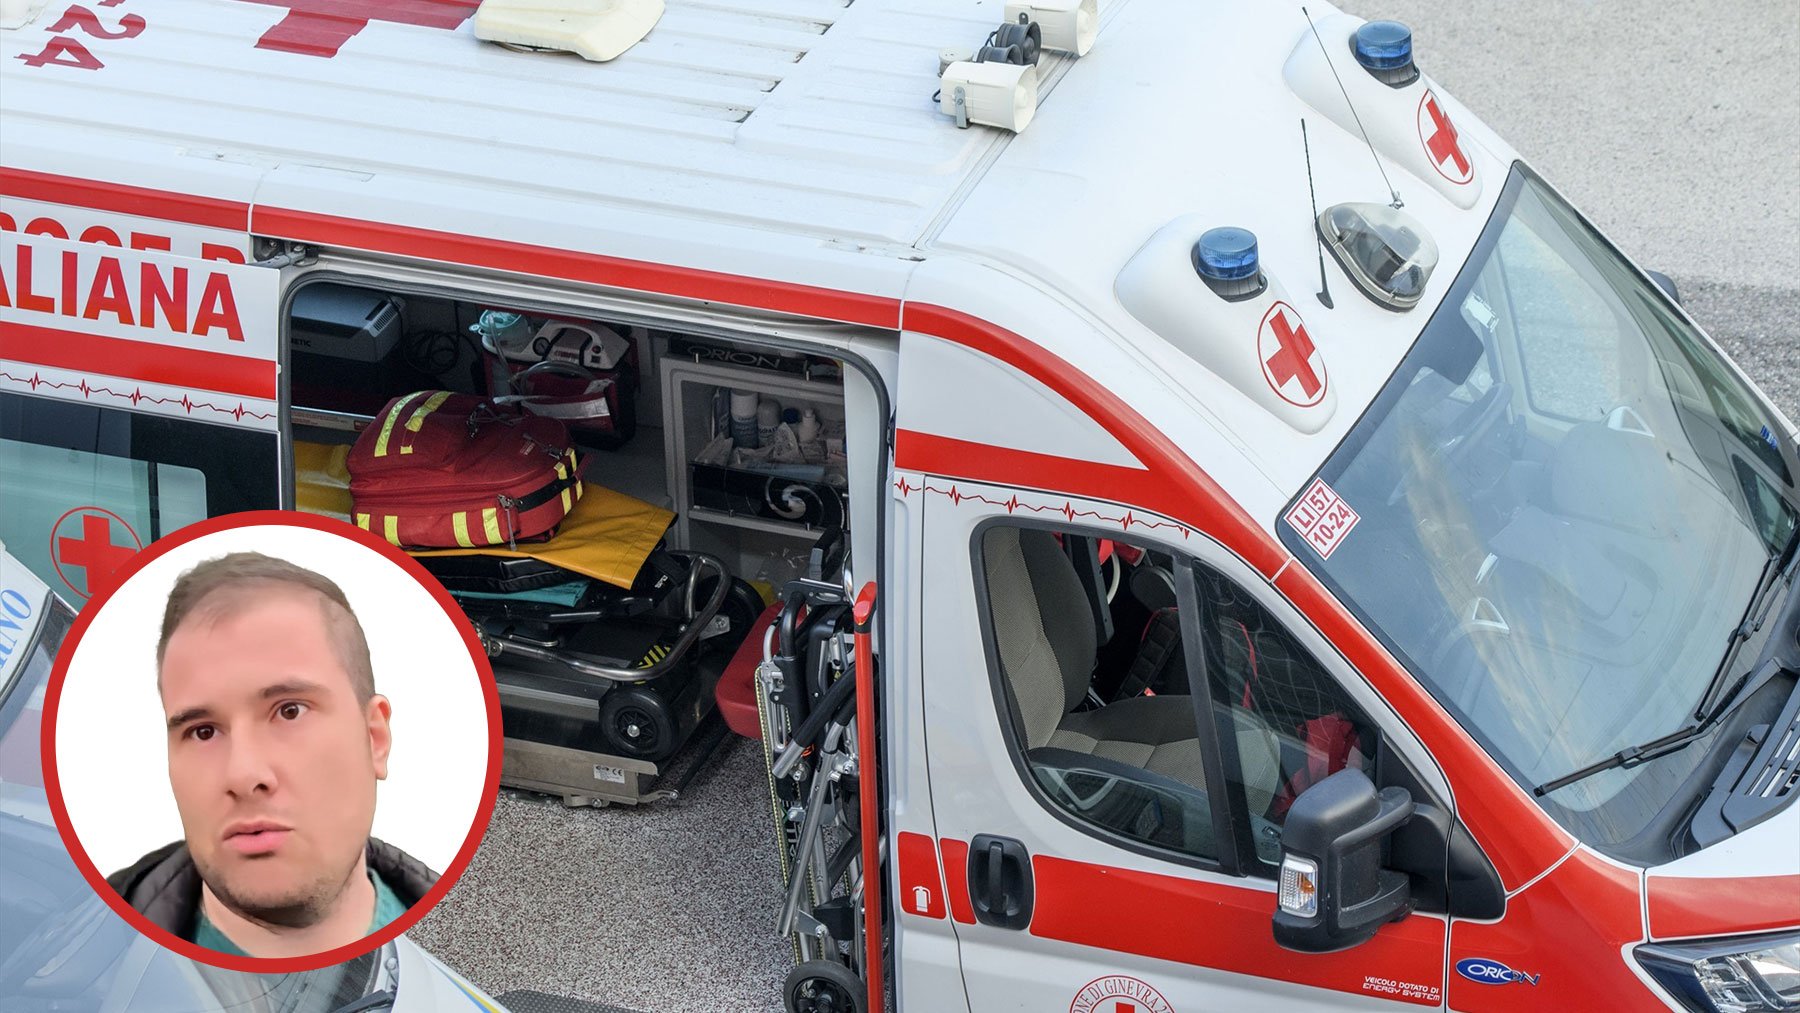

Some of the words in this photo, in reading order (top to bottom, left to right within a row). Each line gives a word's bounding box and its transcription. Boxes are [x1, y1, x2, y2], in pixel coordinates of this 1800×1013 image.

[0, 243, 245, 342] LIANA
[687, 345, 781, 369] ORION
[1294, 506, 1315, 529] LI
[1309, 486, 1330, 511] 57
[1313, 504, 1351, 546] 10-24
[1087, 983, 1104, 1000] DI
[1104, 979, 1159, 1009] GINEVRA
[1362, 982, 1401, 994] ENERGY
[1402, 989, 1440, 1001] SYSTEM
[1364, 976, 1397, 987] VEICOLO
[1399, 982, 1429, 993] DOTATO
